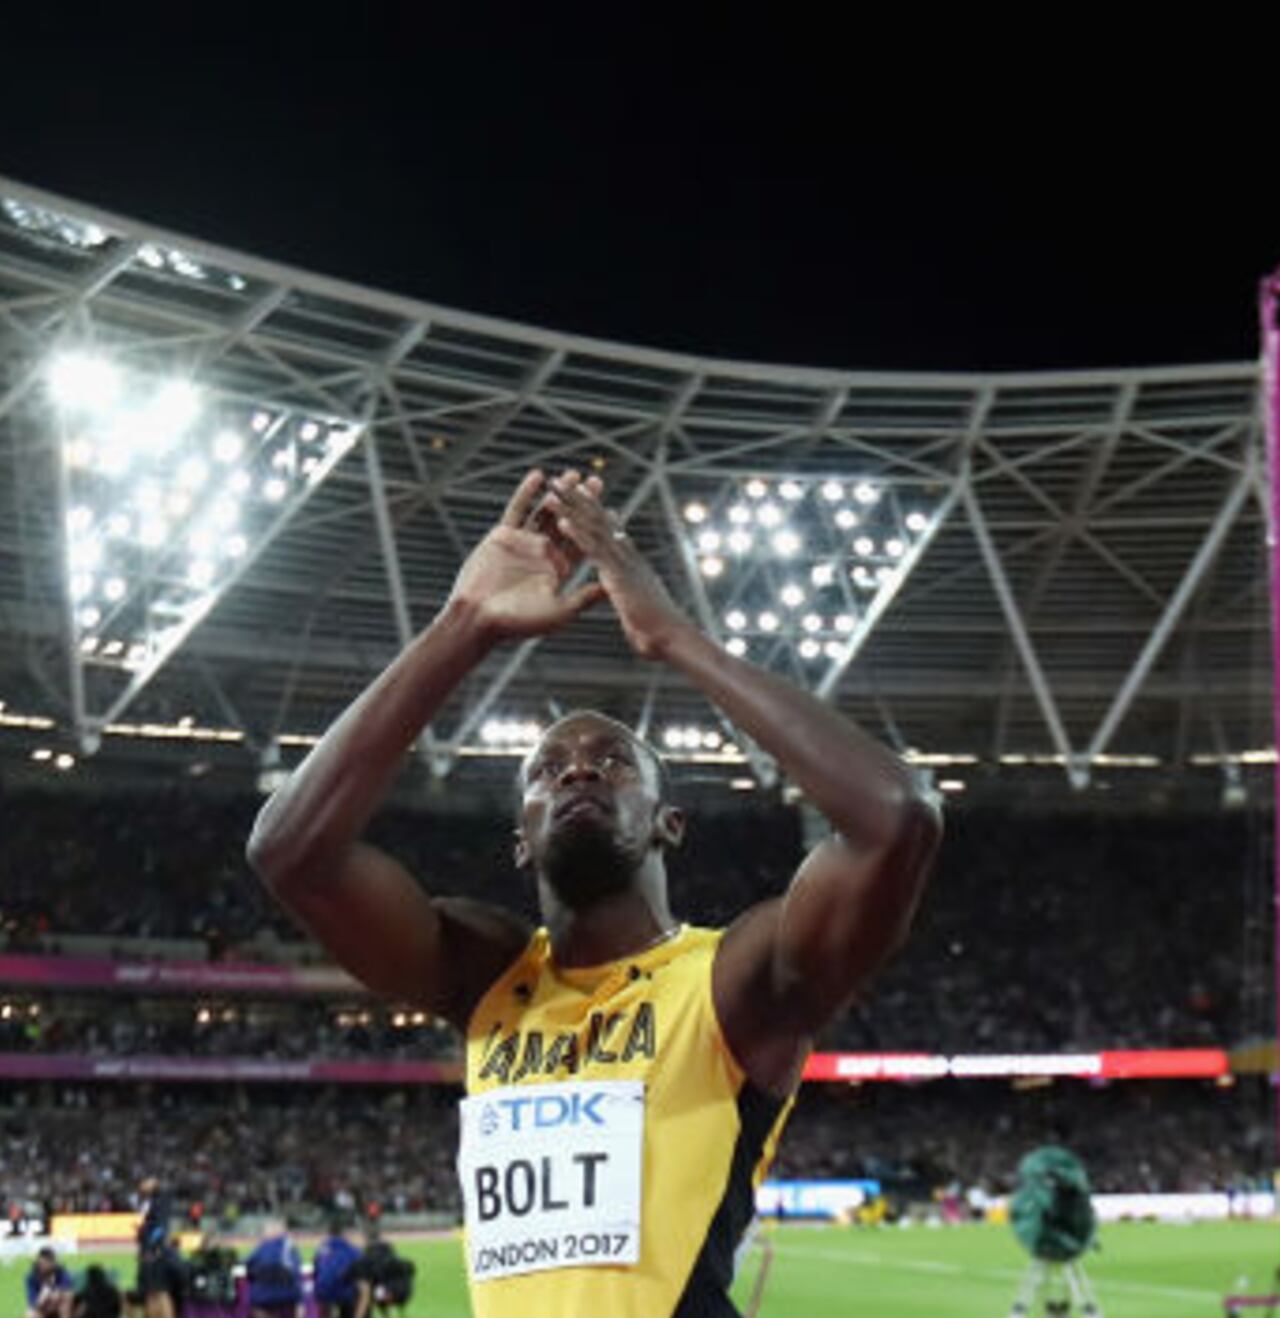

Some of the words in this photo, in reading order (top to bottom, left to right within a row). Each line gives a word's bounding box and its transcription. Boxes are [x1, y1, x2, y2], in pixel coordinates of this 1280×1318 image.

[498, 1091, 606, 1131] TDK
[476, 1152, 609, 1222] BOLT
[564, 1233, 630, 1259] 2017
